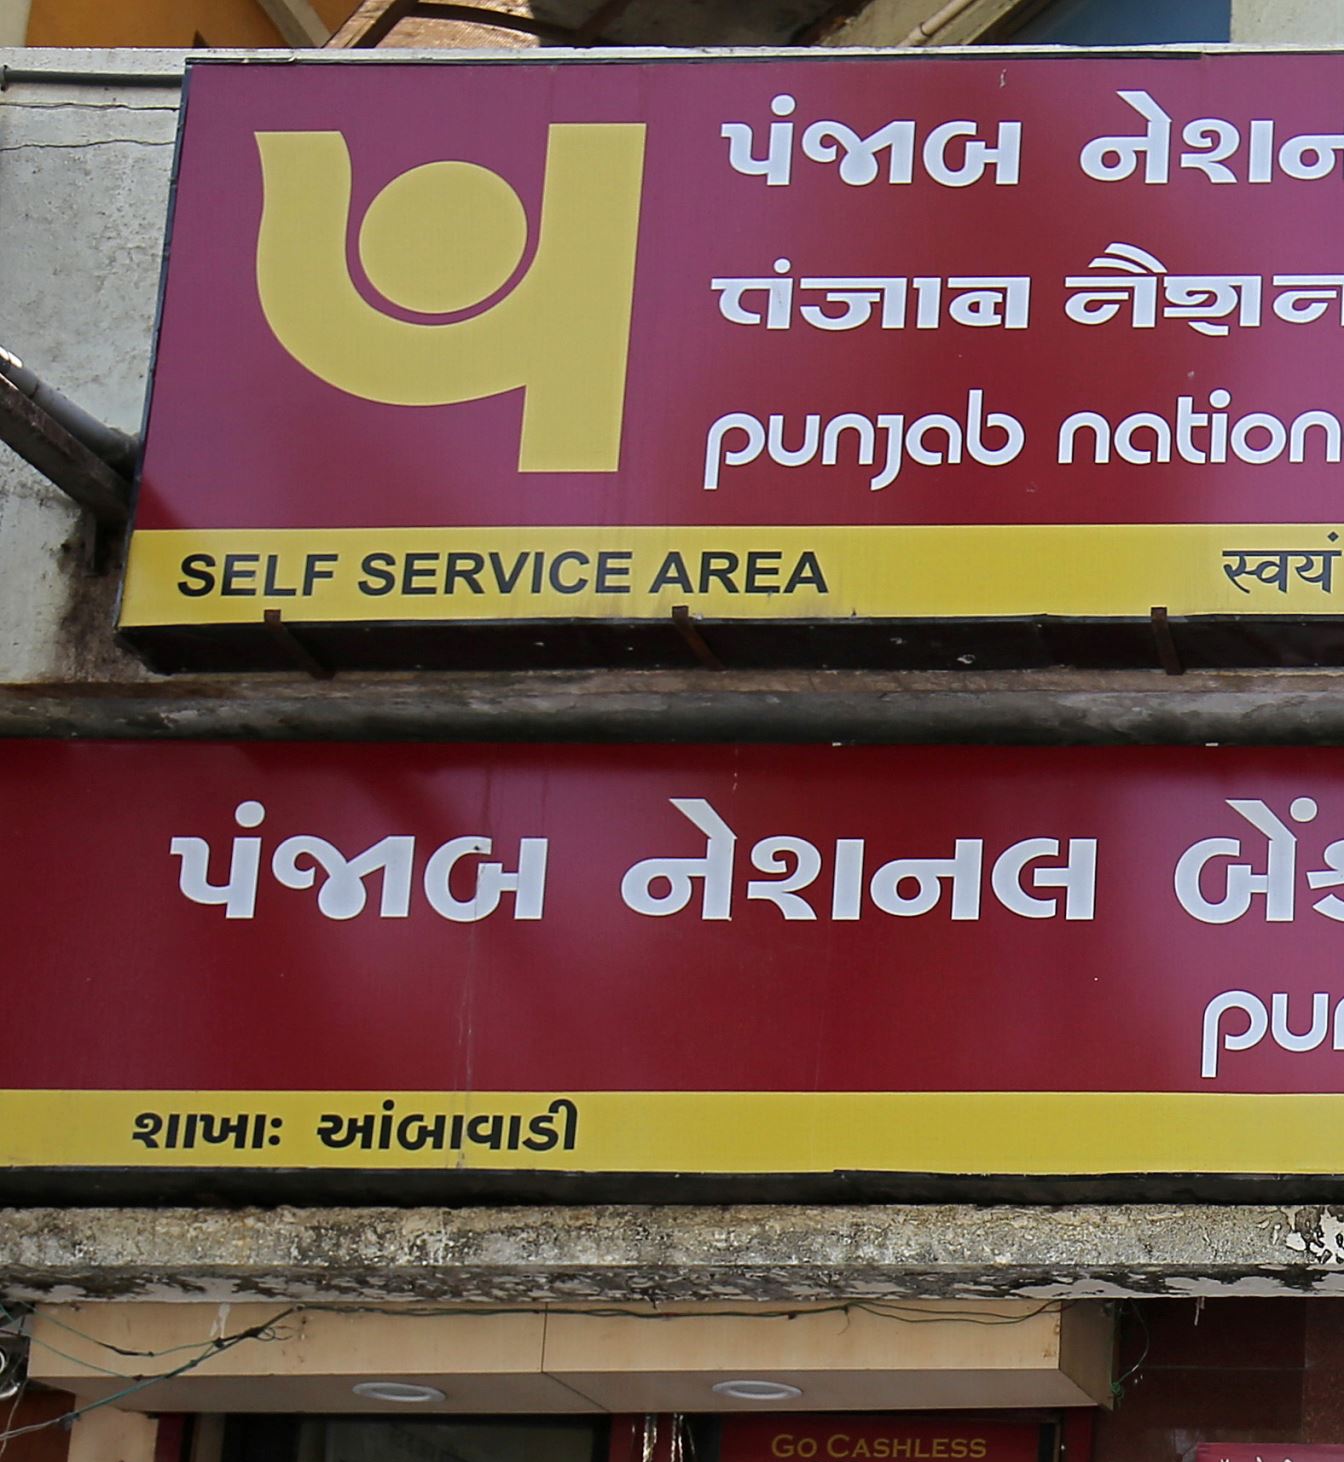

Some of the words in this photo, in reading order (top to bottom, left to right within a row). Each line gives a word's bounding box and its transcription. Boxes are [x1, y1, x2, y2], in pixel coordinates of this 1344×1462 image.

[720, 93, 1022, 188] પંજાબ
[710, 257, 1030, 331] पंजाब
[703, 389, 1025, 491] punjab
[177, 553, 340, 598] SELF
[357, 552, 632, 596] SERVICE
[648, 551, 829, 595] AREA
[1222, 532, 1342, 594] स्वयं
[170, 800, 549, 922] પંજાબ
[620, 798, 1098, 922] નેશનલ
[316, 1099, 580, 1151] આંબાવાડી
